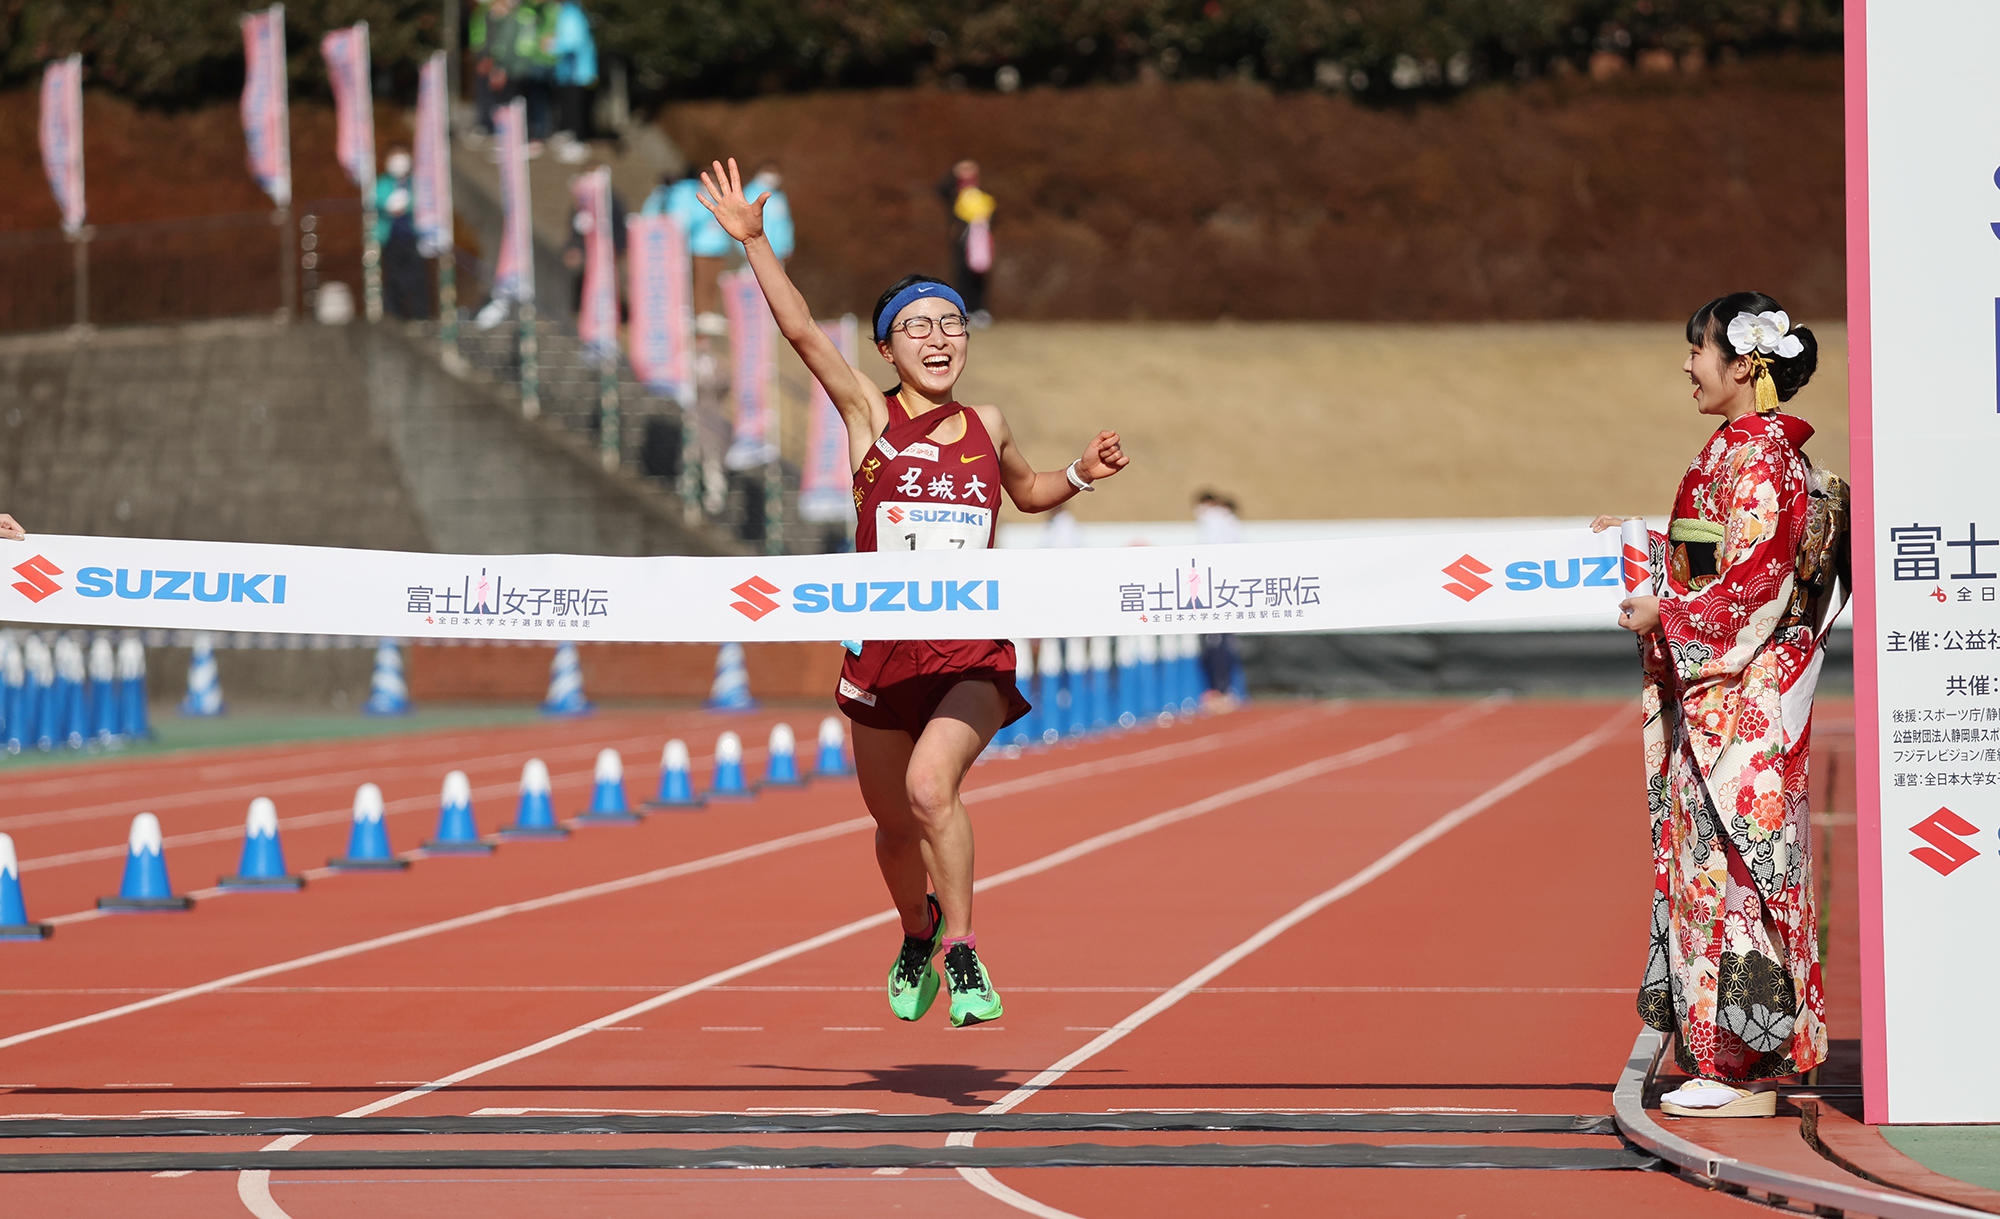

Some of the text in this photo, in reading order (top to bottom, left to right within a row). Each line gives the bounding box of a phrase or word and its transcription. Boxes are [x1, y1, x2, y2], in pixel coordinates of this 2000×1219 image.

[896, 467, 988, 504] 名城大
[909, 509, 983, 527] SUZUKI
[1890, 522, 2000, 582] 富士
[76, 566, 287, 605] SUZUKI
[1119, 558, 1321, 612] 富士山女子駅伝
[1506, 556, 1624, 592] SUZ
[407, 568, 609, 616] 富士山女子駅伝
[793, 579, 999, 614] SUZUKI
[1956, 586, 1996, 602] 全日
[438, 616, 591, 629] 全日本大学女子選抜駅伝競走
[1152, 609, 1305, 623] 全日本大学女子選抜駅伝競走
[1892, 707, 2000, 724] 後援：スポーツ庁/静
[1894, 772, 2000, 788] 運営：全日本大学女
